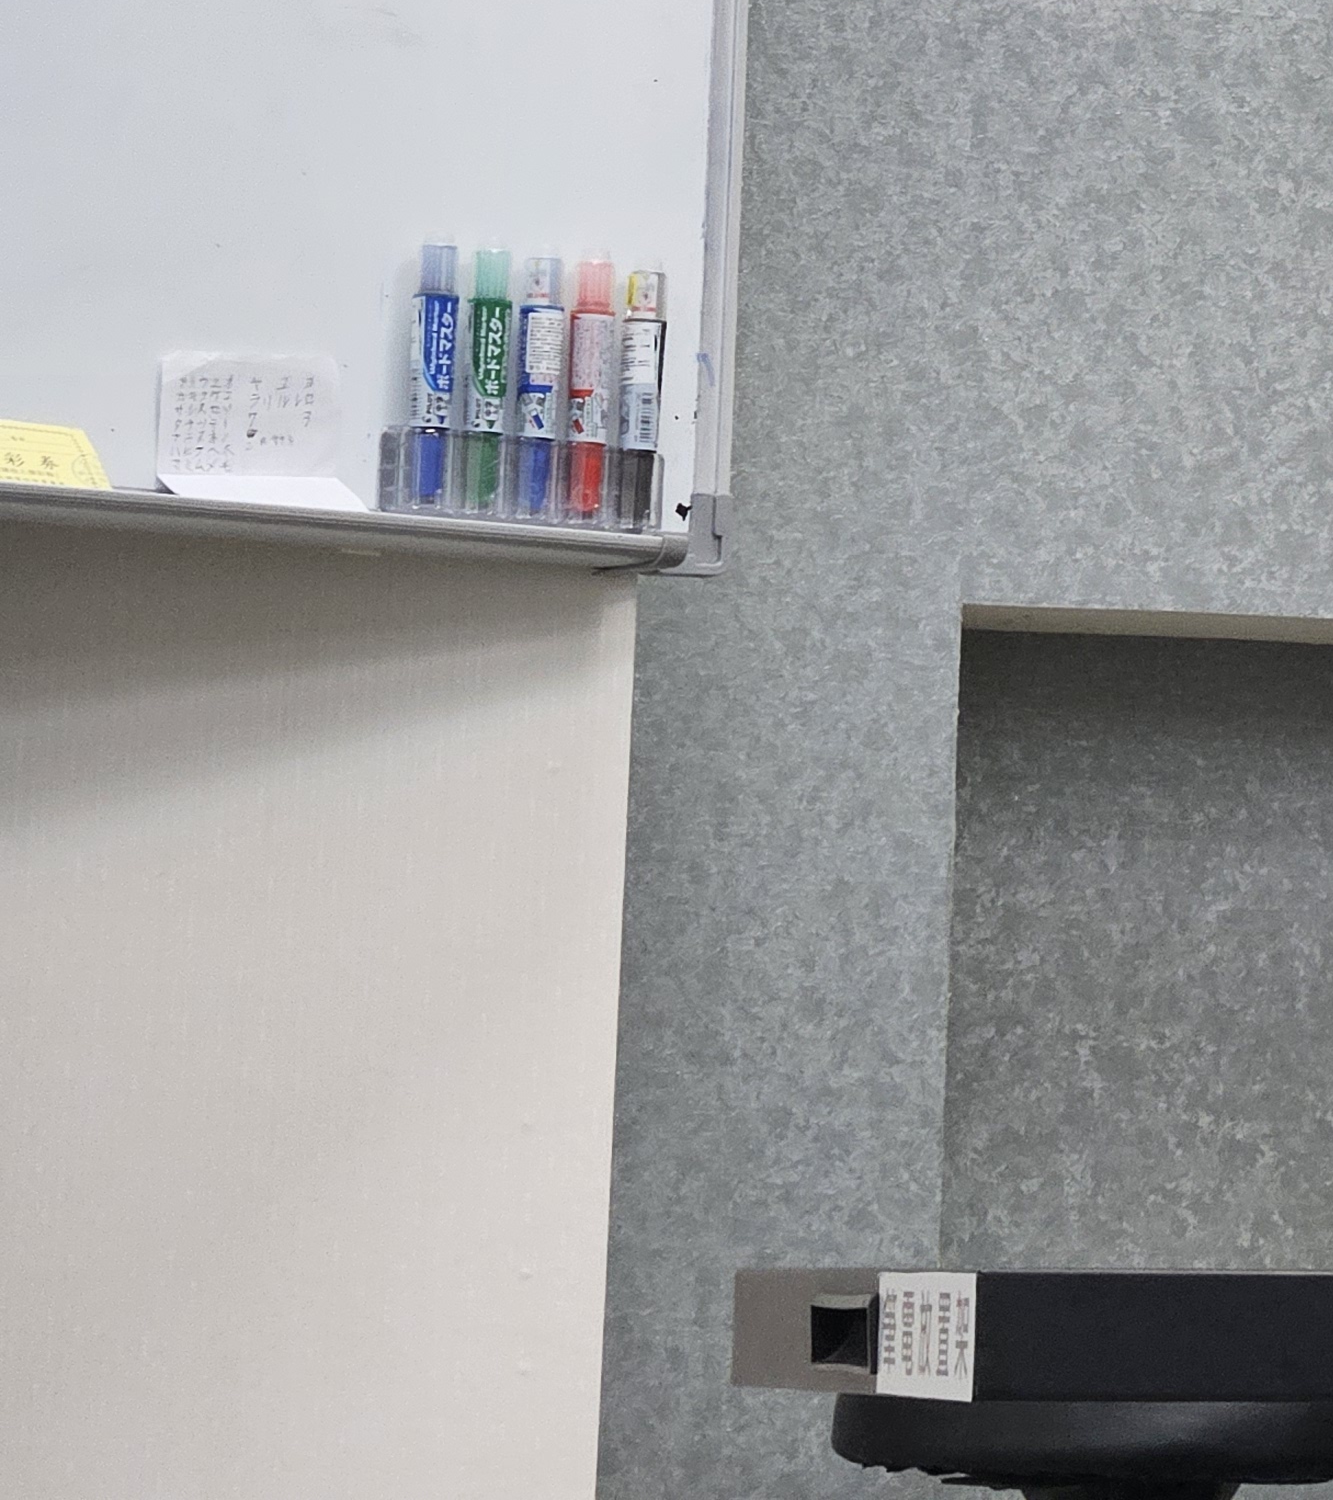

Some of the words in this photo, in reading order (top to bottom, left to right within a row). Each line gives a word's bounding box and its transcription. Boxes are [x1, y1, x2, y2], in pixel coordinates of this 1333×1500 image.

[437, 301, 454, 390] ボードマスター
[485, 307, 503, 395] ボードマスター
